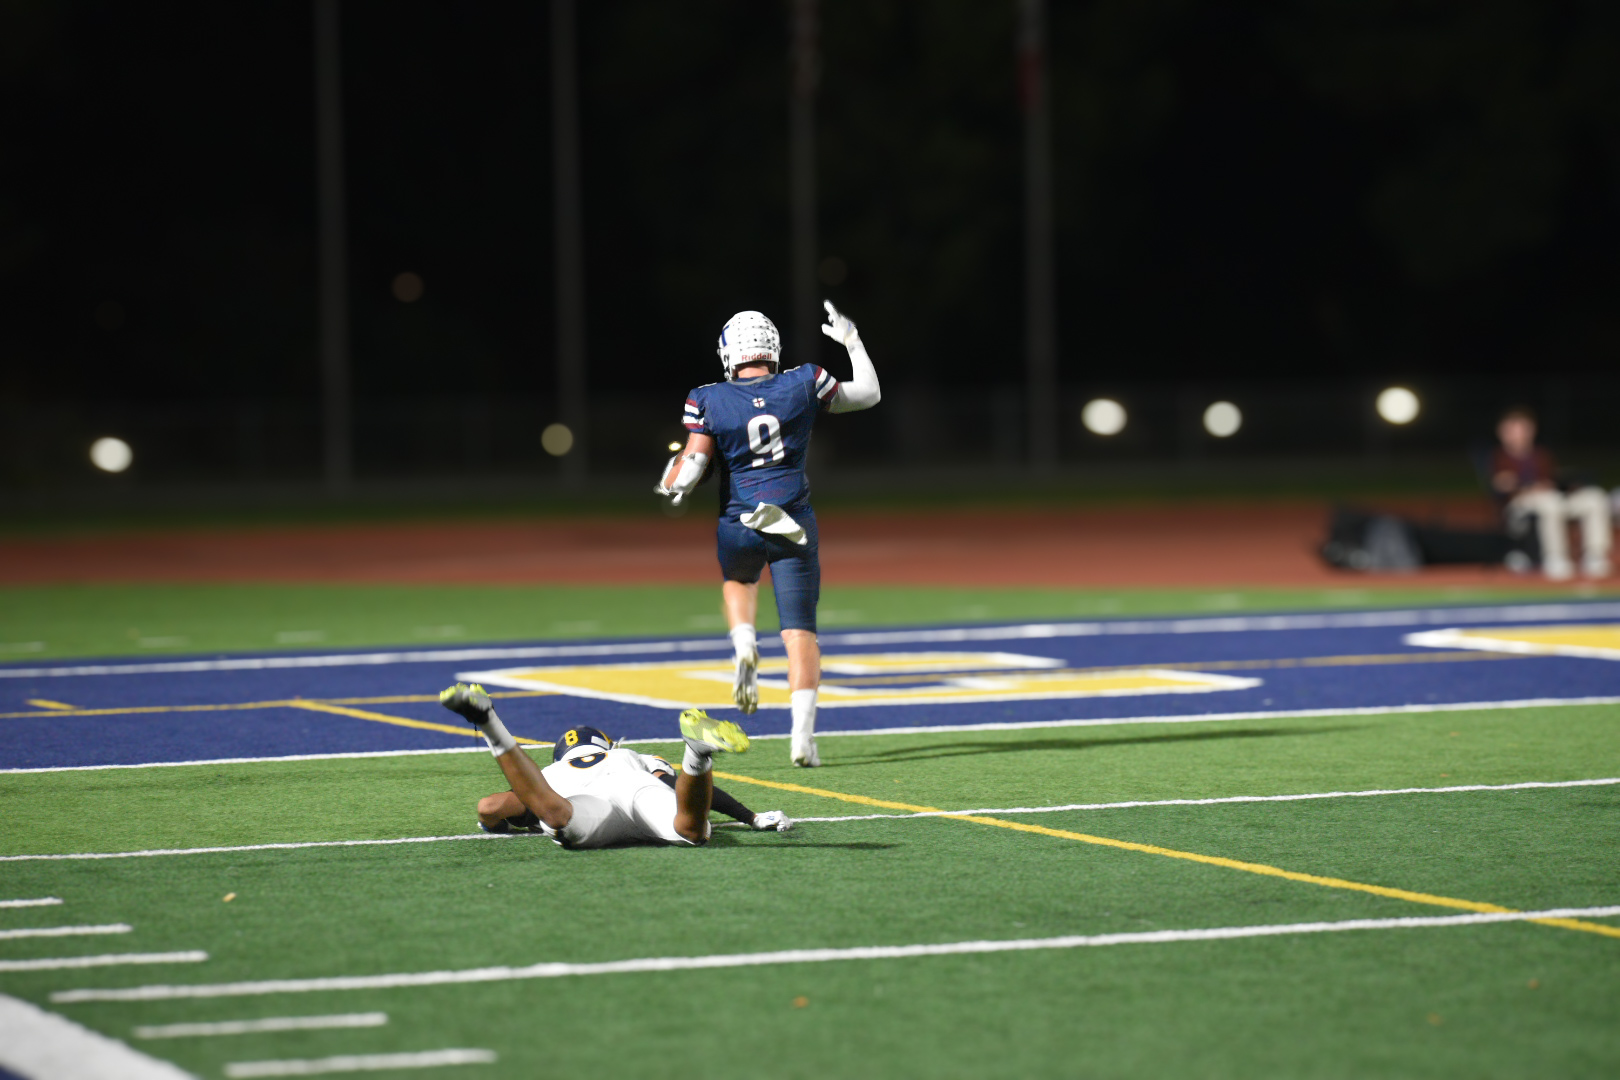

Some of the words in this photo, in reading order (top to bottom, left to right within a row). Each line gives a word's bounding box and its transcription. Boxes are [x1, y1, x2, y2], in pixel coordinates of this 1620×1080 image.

[742, 353, 772, 361] Riddell
[747, 414, 785, 468] 9
[565, 730, 579, 746] 8
